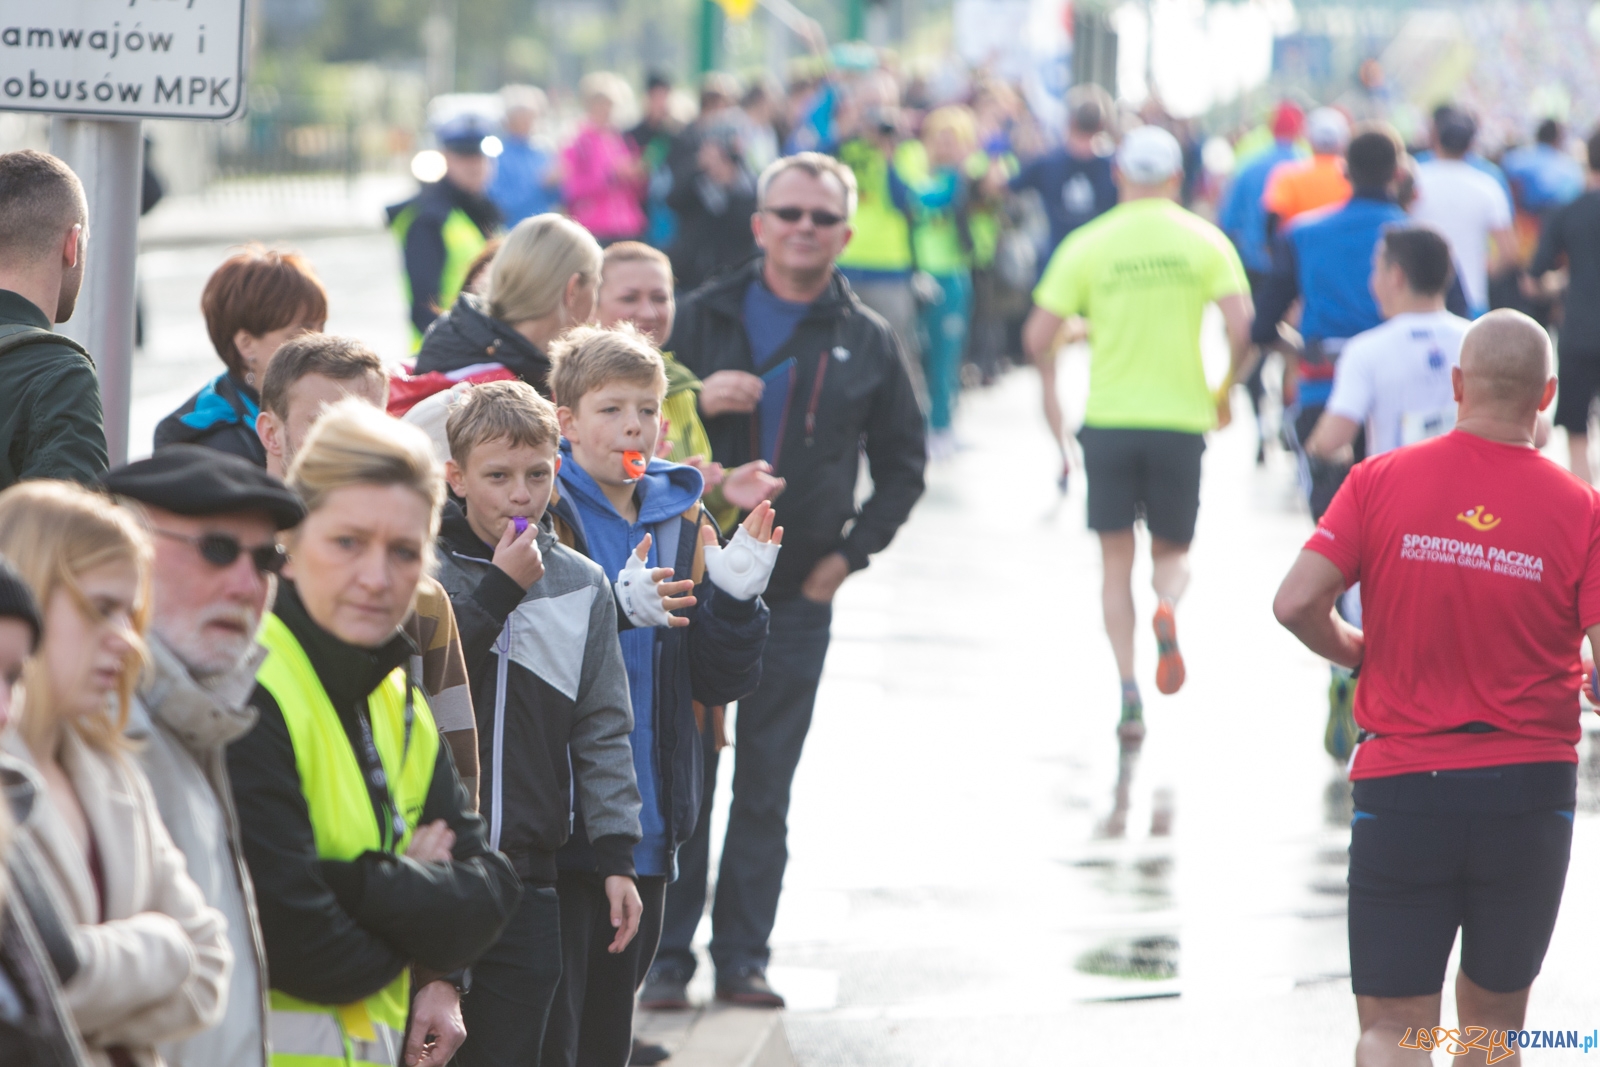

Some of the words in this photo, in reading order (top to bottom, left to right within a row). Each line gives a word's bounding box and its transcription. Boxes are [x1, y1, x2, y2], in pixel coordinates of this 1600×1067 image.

[0, 20, 173, 59] amwajów
[198, 24, 206, 54] i
[0, 69, 142, 103] obusów
[153, 75, 231, 107] MPK
[1401, 547, 1456, 564] POCZTOWA
[1457, 555, 1491, 571] GRUPA
[1493, 562, 1542, 583] BIEGOWA
[1402, 533, 1484, 558] SPORTOWA
[1488, 546, 1544, 572] PACZKA
